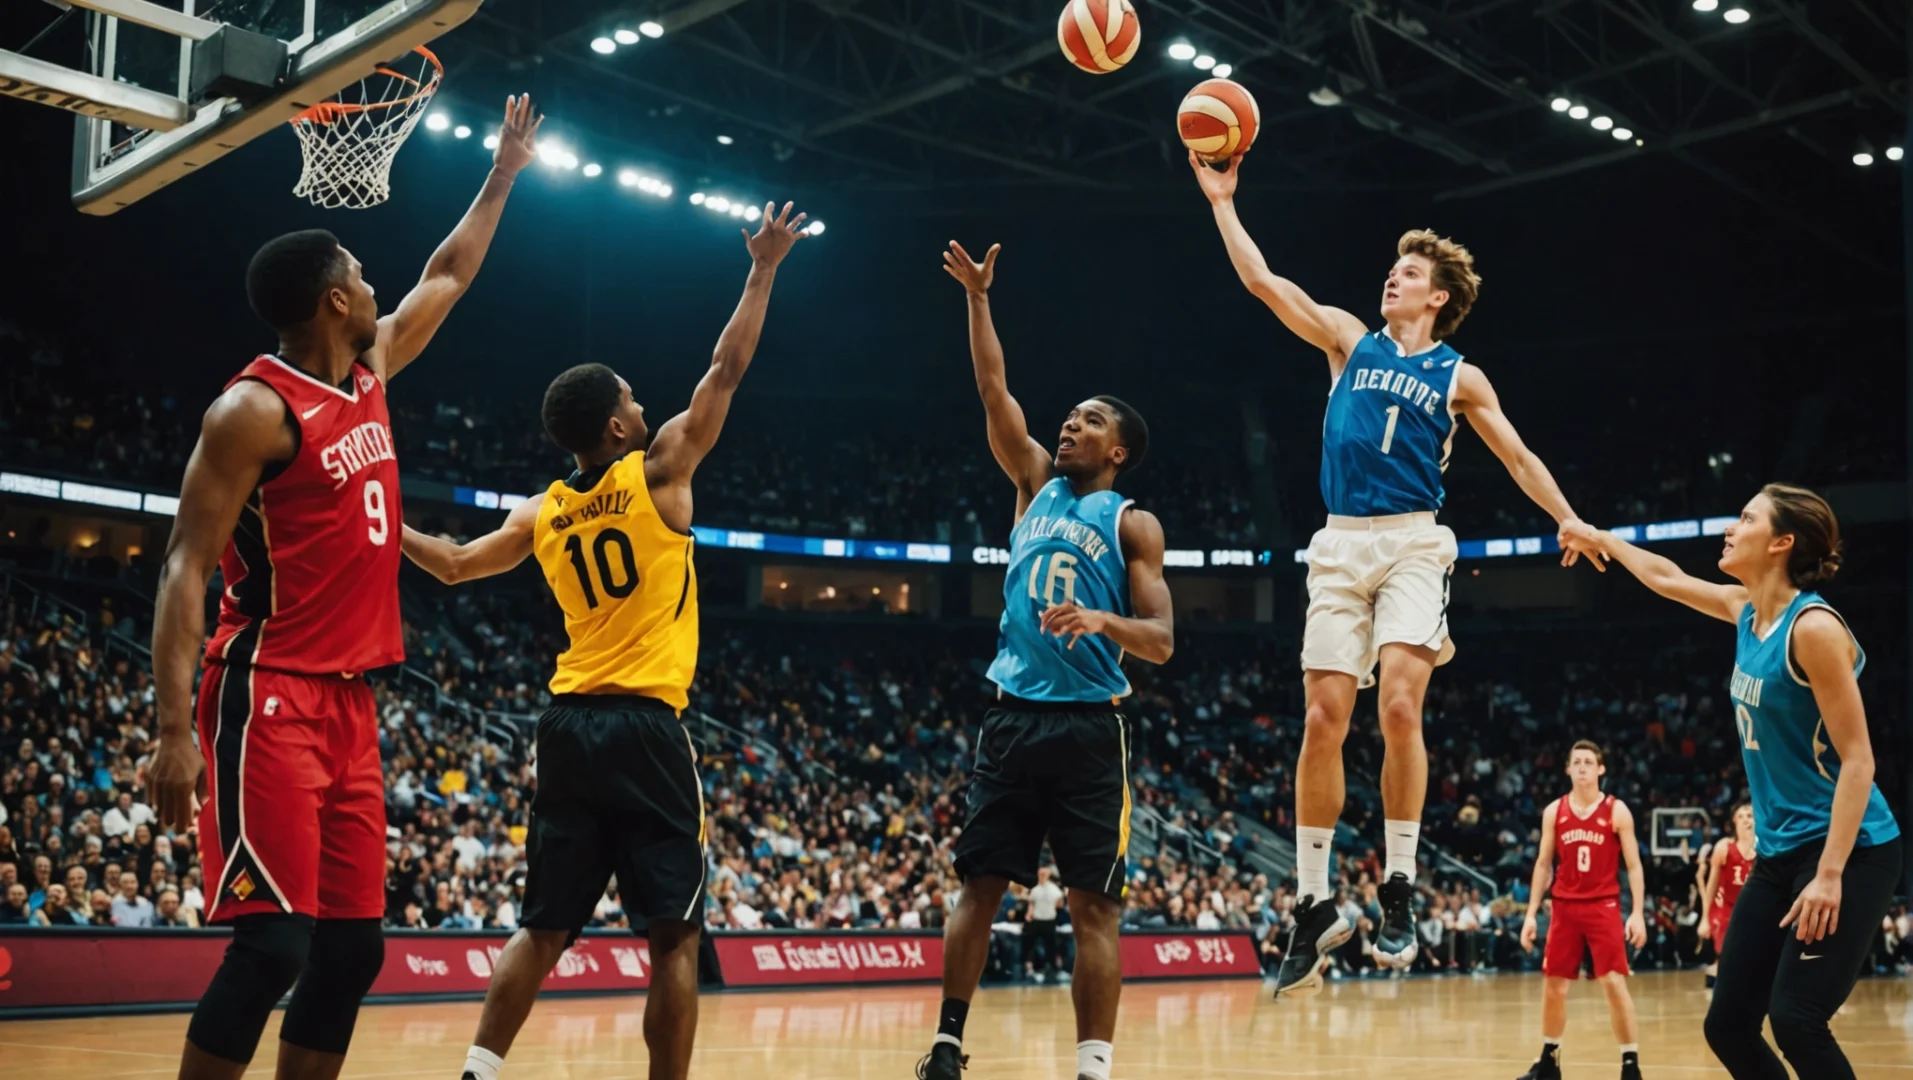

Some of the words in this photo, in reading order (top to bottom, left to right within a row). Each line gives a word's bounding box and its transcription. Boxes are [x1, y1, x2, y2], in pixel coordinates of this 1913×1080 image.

[1380, 404, 1401, 455] 1
[363, 480, 389, 546] 9
[564, 527, 640, 610] 10
